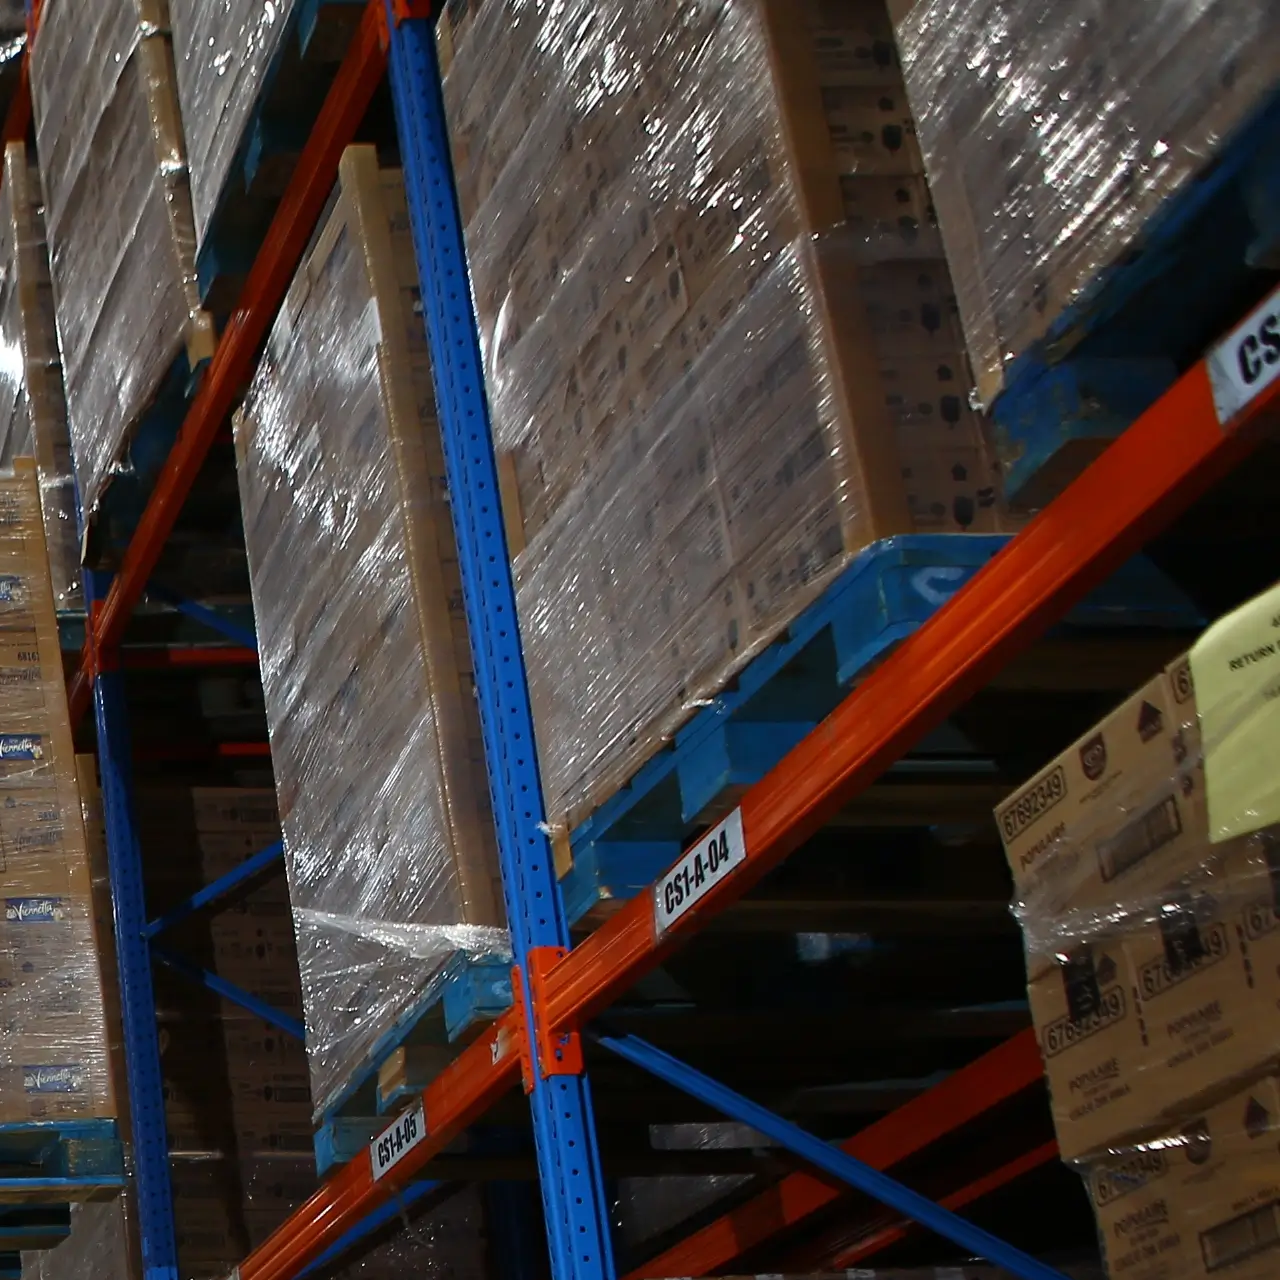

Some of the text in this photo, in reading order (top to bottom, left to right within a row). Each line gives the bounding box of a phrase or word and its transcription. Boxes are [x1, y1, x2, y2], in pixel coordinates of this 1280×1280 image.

[1228, 644, 1276, 672] RETURN
[1003, 774, 1062, 837] 67692349
[664, 830, 730, 914] CS1-A-04
[15, 901, 52, 921] Viennetta
[377, 1114, 418, 1168] CS1-A-05
